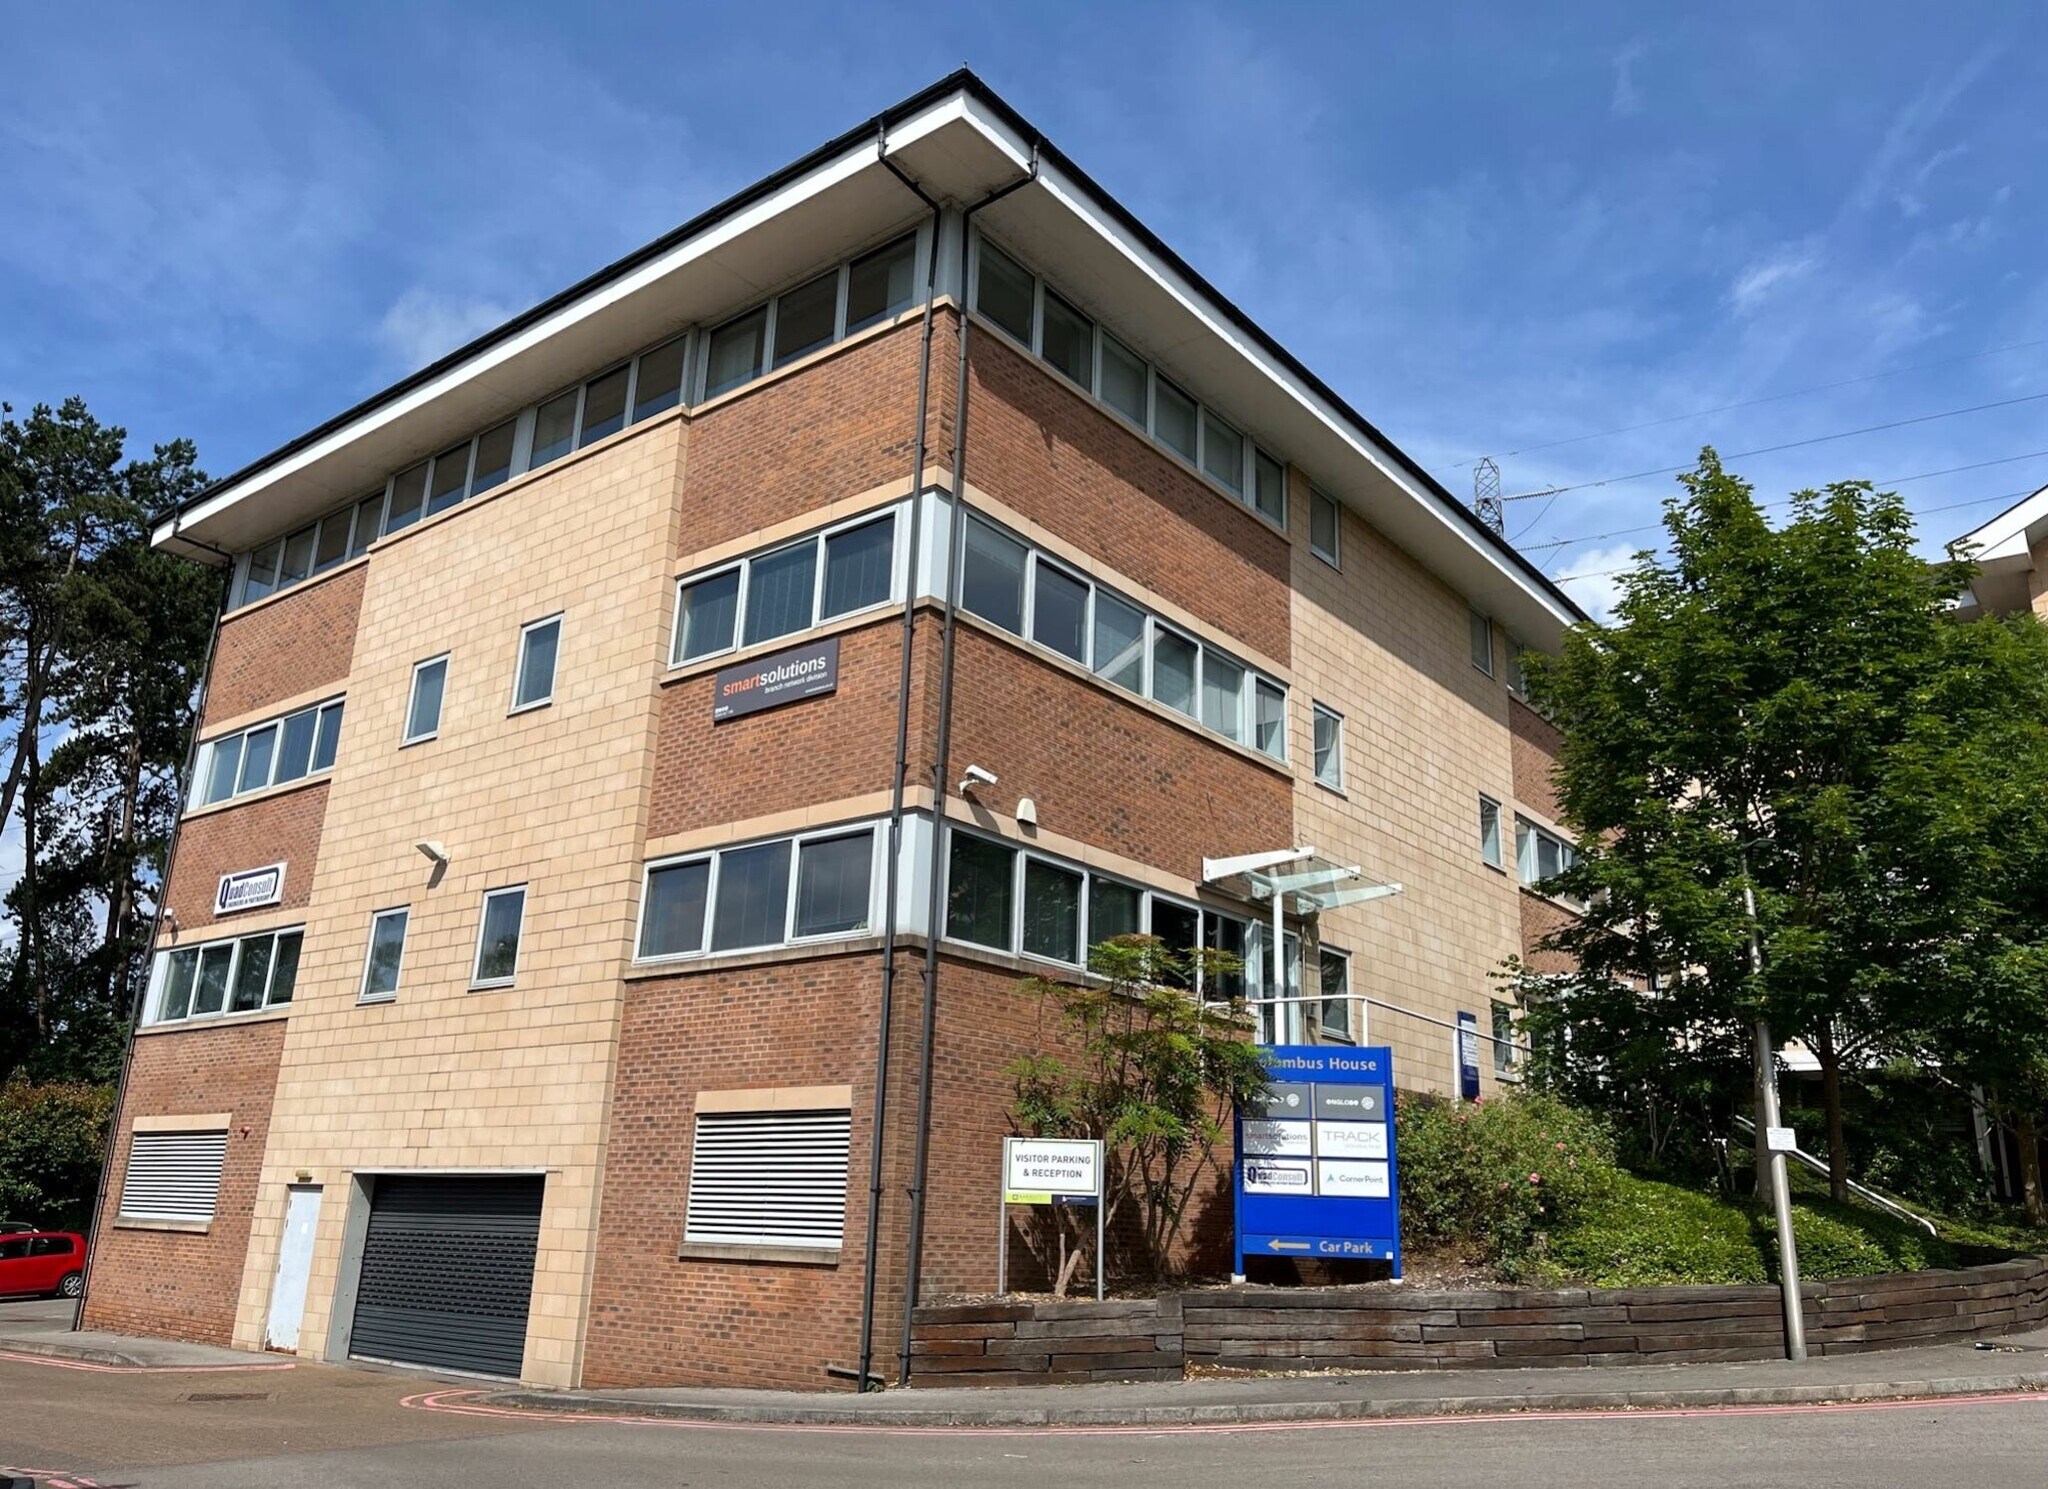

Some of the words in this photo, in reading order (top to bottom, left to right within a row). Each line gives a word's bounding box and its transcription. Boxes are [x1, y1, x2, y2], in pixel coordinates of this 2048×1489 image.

[723, 656, 826, 696] smartsolutions
[219, 877, 274, 909] QuadConsult
[1329, 1057, 1377, 1071] House
[1323, 1131, 1381, 1143] TRACK
[1015, 1154, 1049, 1163] VISITOR
[1051, 1155, 1091, 1165] PARKING
[1023, 1168, 1029, 1177] &
[1032, 1169, 1082, 1178] RECEPTION
[1319, 1241, 1341, 1253] Car
[1343, 1242, 1373, 1254] Park
